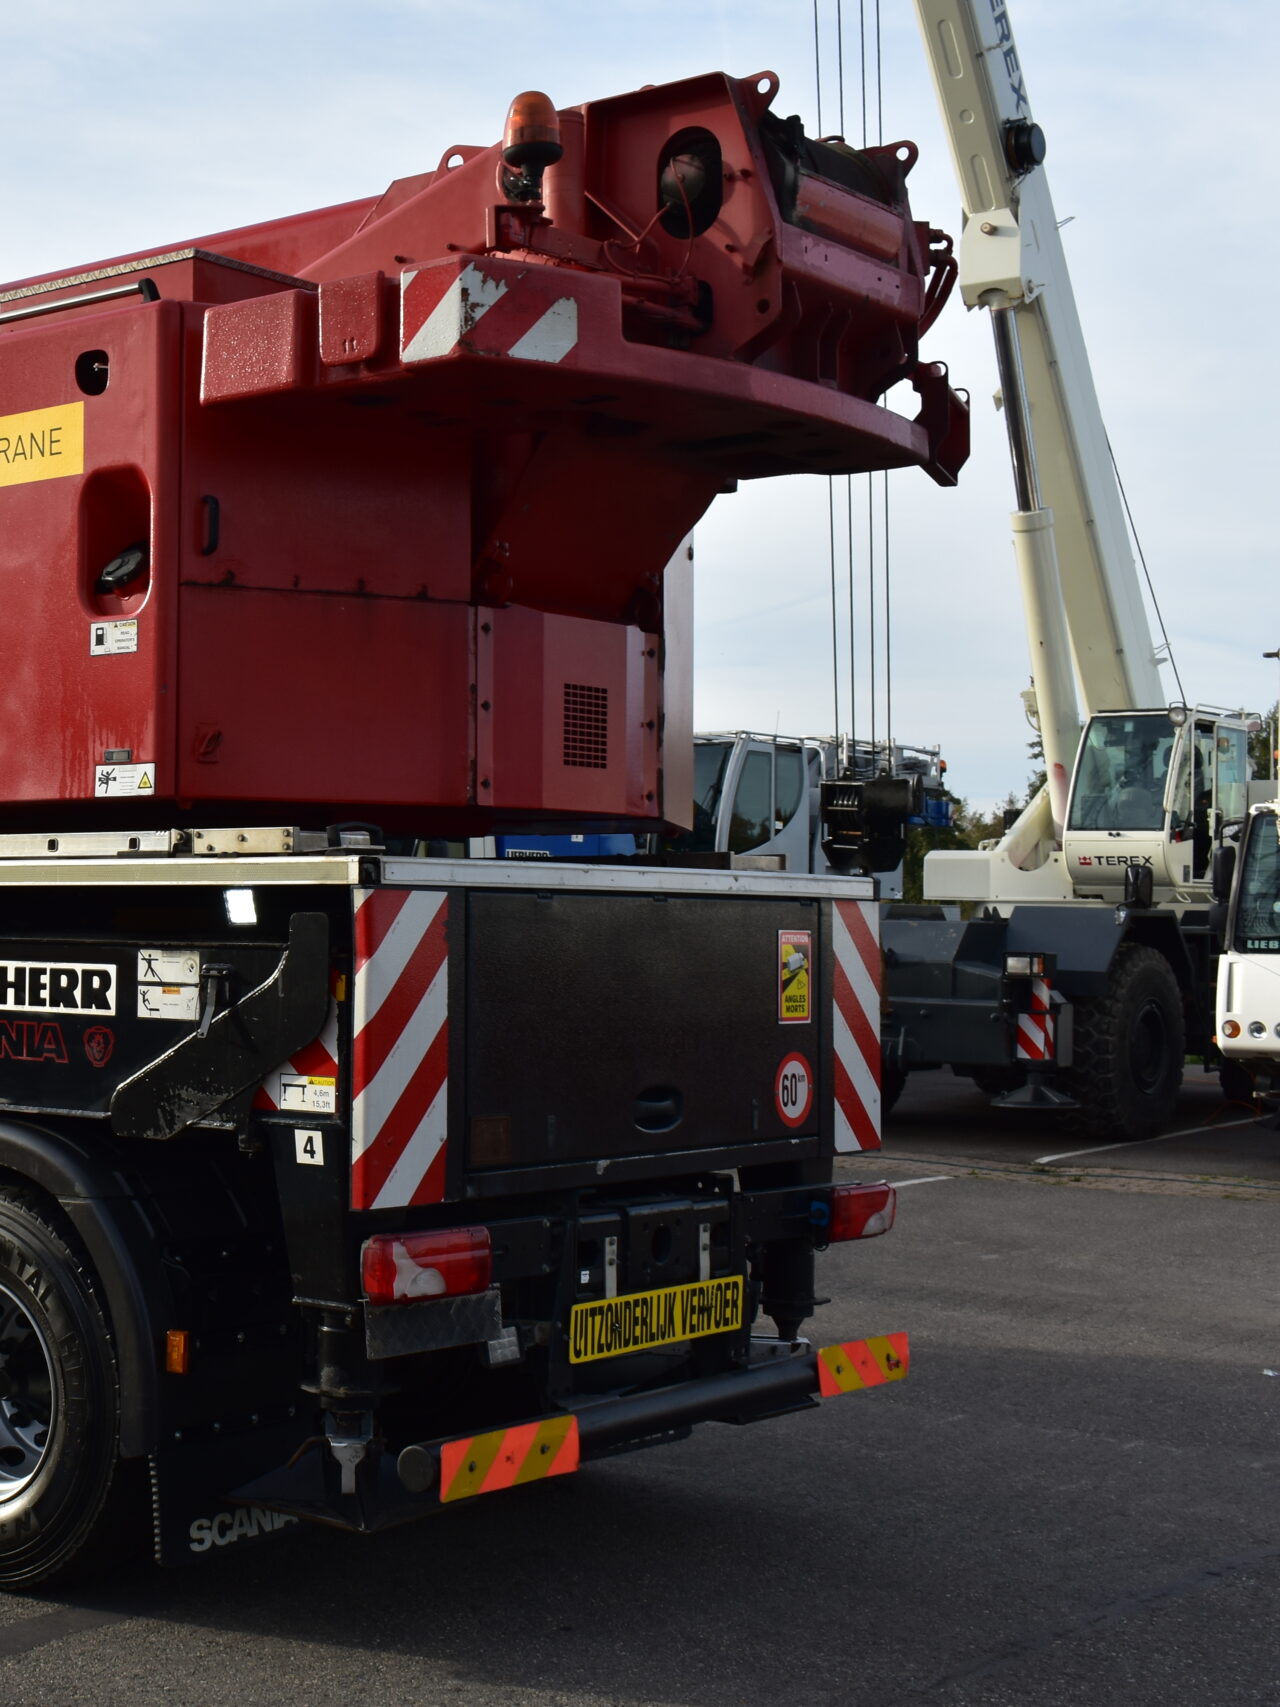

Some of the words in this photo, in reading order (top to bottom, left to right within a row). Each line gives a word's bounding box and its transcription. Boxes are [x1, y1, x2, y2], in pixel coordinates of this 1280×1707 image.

[1093, 856, 1154, 866] TEREX
[781, 934, 809, 945] ATTENTION
[1247, 939, 1280, 949] LIEB
[784, 993, 807, 1005] ANGLES
[785, 1003, 806, 1014] MORTS
[781, 1072, 798, 1108] 60
[797, 1072, 806, 1083] km
[303, 1135, 317, 1160] 4
[573, 1290, 677, 1360] UITZONDERLIJK
[680, 1280, 740, 1336] VERVOER
